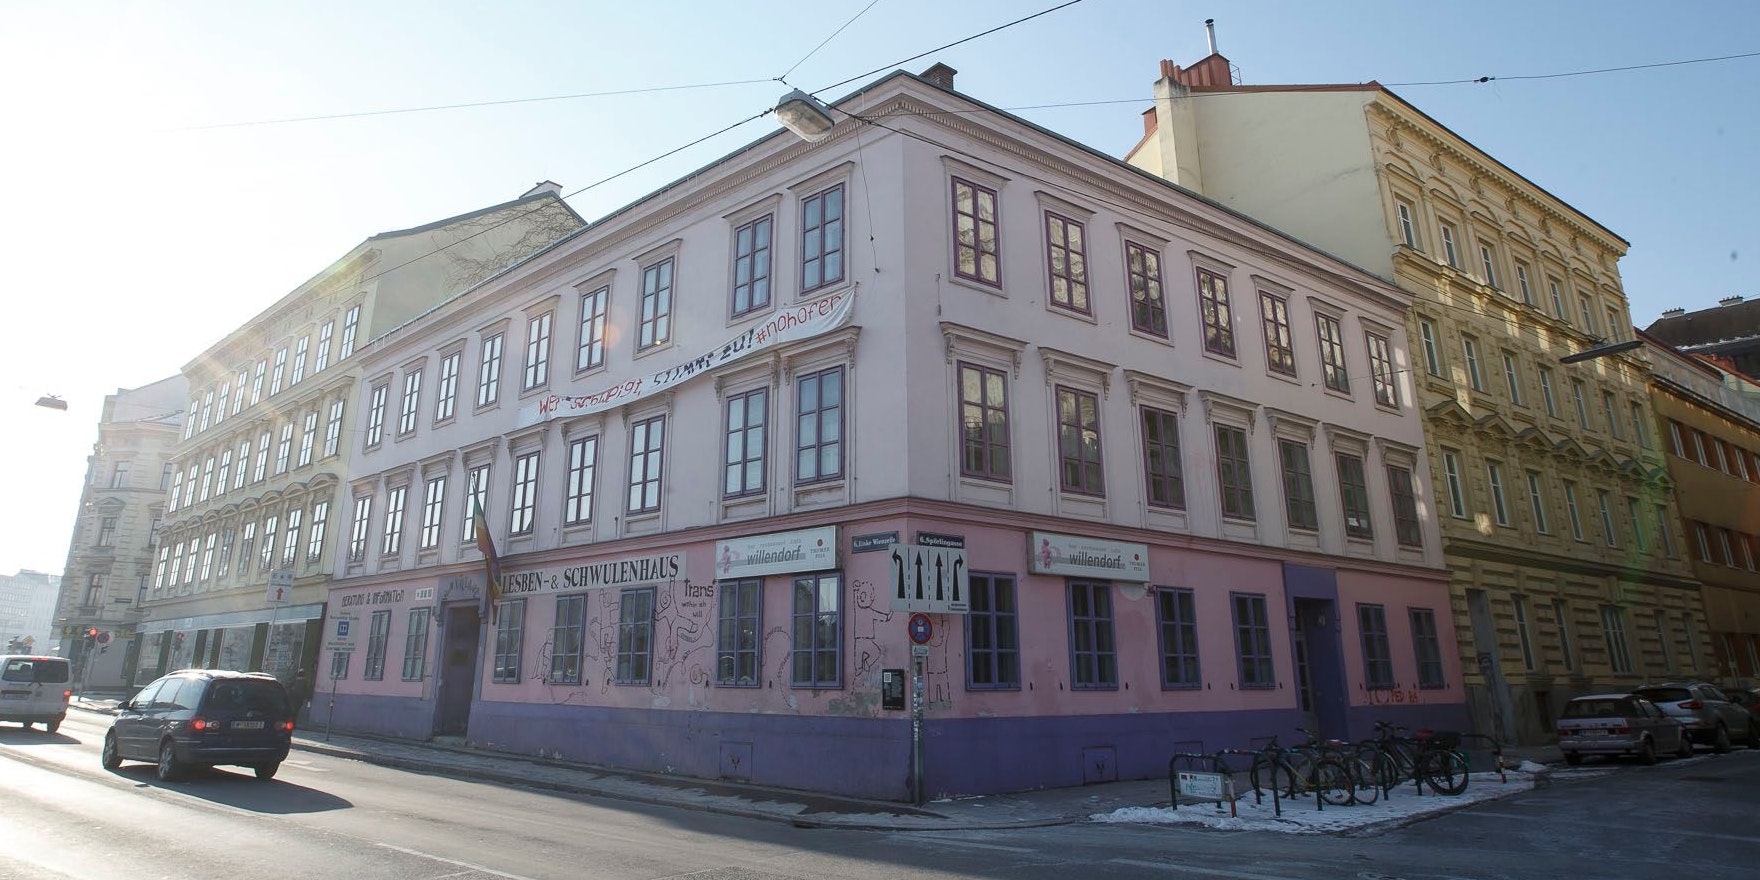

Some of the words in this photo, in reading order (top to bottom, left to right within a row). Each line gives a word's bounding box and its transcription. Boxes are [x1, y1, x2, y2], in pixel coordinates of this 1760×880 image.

[747, 545, 802, 566] willendorf
[1070, 551, 1122, 569] willendorf
[551, 574, 559, 590] &
[563, 554, 680, 589] SCHWULENHAUS
